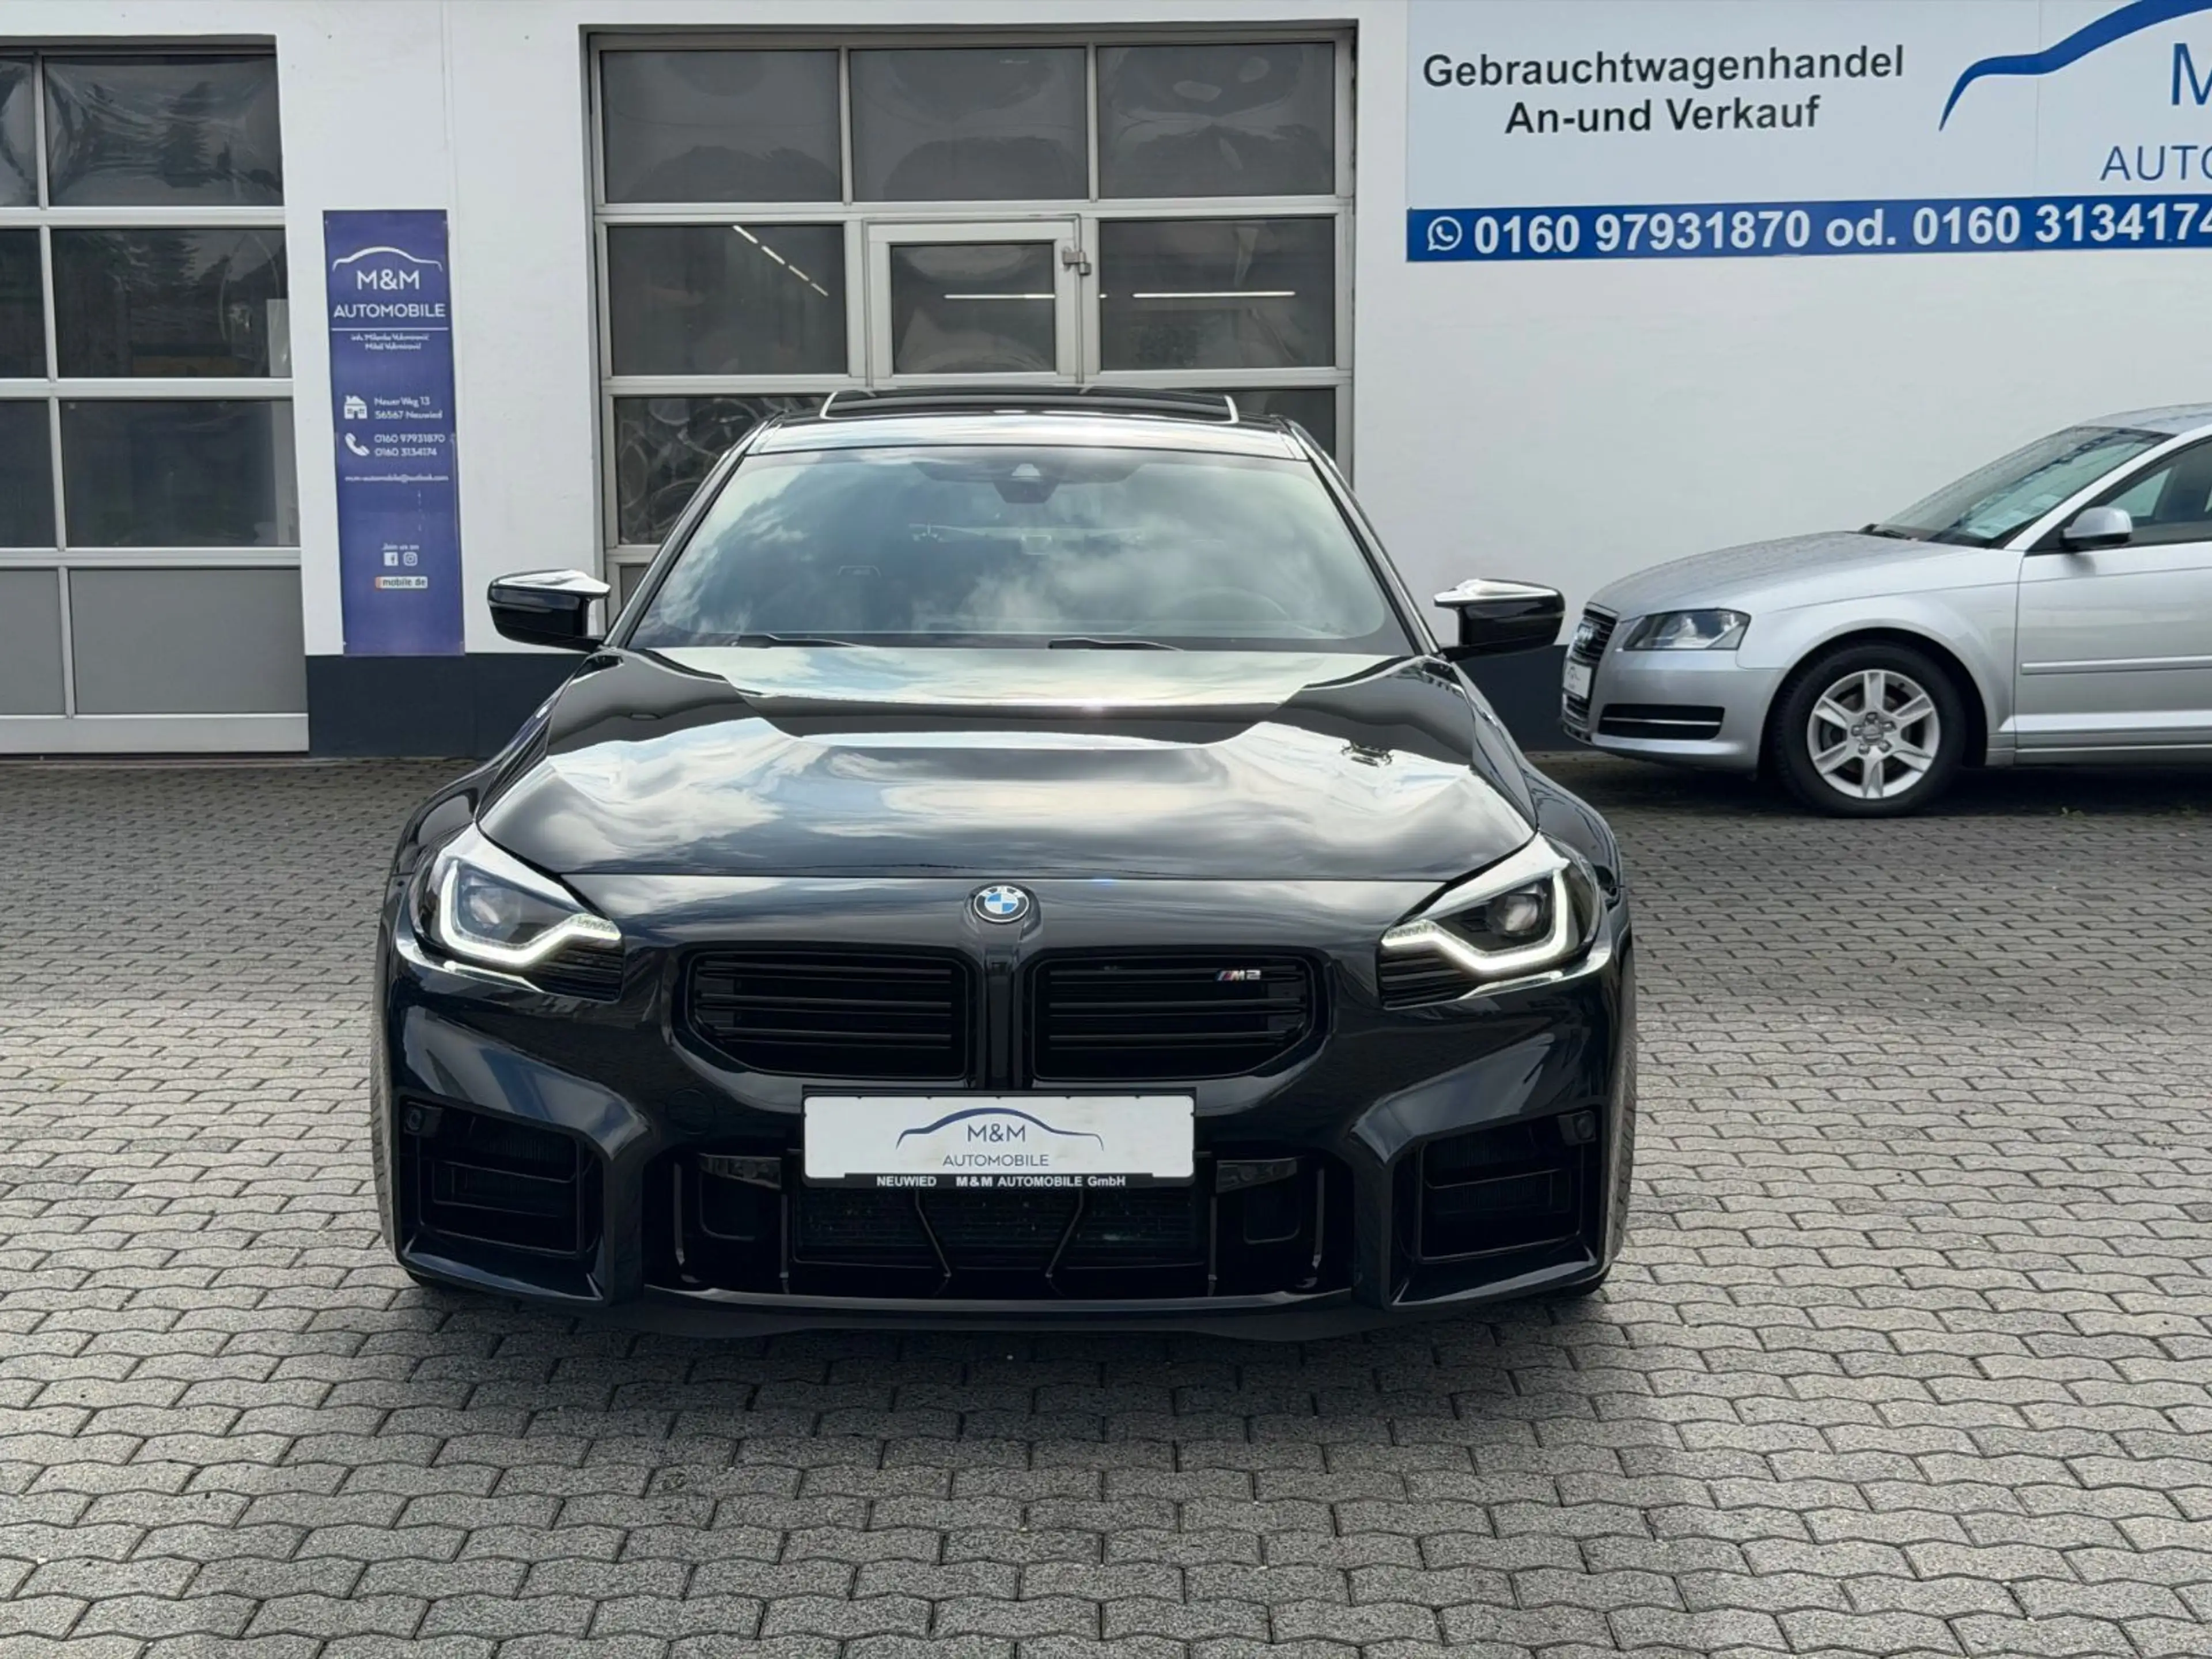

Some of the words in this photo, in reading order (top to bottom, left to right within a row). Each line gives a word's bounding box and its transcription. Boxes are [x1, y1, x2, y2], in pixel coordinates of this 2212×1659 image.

[1423, 44, 1903, 90] Gebrauchtwagenhandel
[1505, 99, 1652, 134] An-und
[1665, 94, 1821, 131] Verkauf
[1474, 214, 1580, 254] 0160
[1595, 210, 1810, 252] 97931870
[1825, 208, 1896, 247] od.
[1912, 206, 2020, 245] 0160
[357, 268, 419, 290] M&M
[334, 303, 445, 318] AUTOMOBILE
[374, 434, 398, 443] 0160
[400, 434, 445, 443] 97931870
[375, 448, 399, 456] 0160
[967, 1123, 1026, 1143] M&M
[942, 1154, 1049, 1167] AUTOMOBILE
[876, 1176, 937, 1187] NEUWIED
[997, 1176, 1082, 1187] AUTOMOBILE
[1087, 1176, 1126, 1187] GmbH
